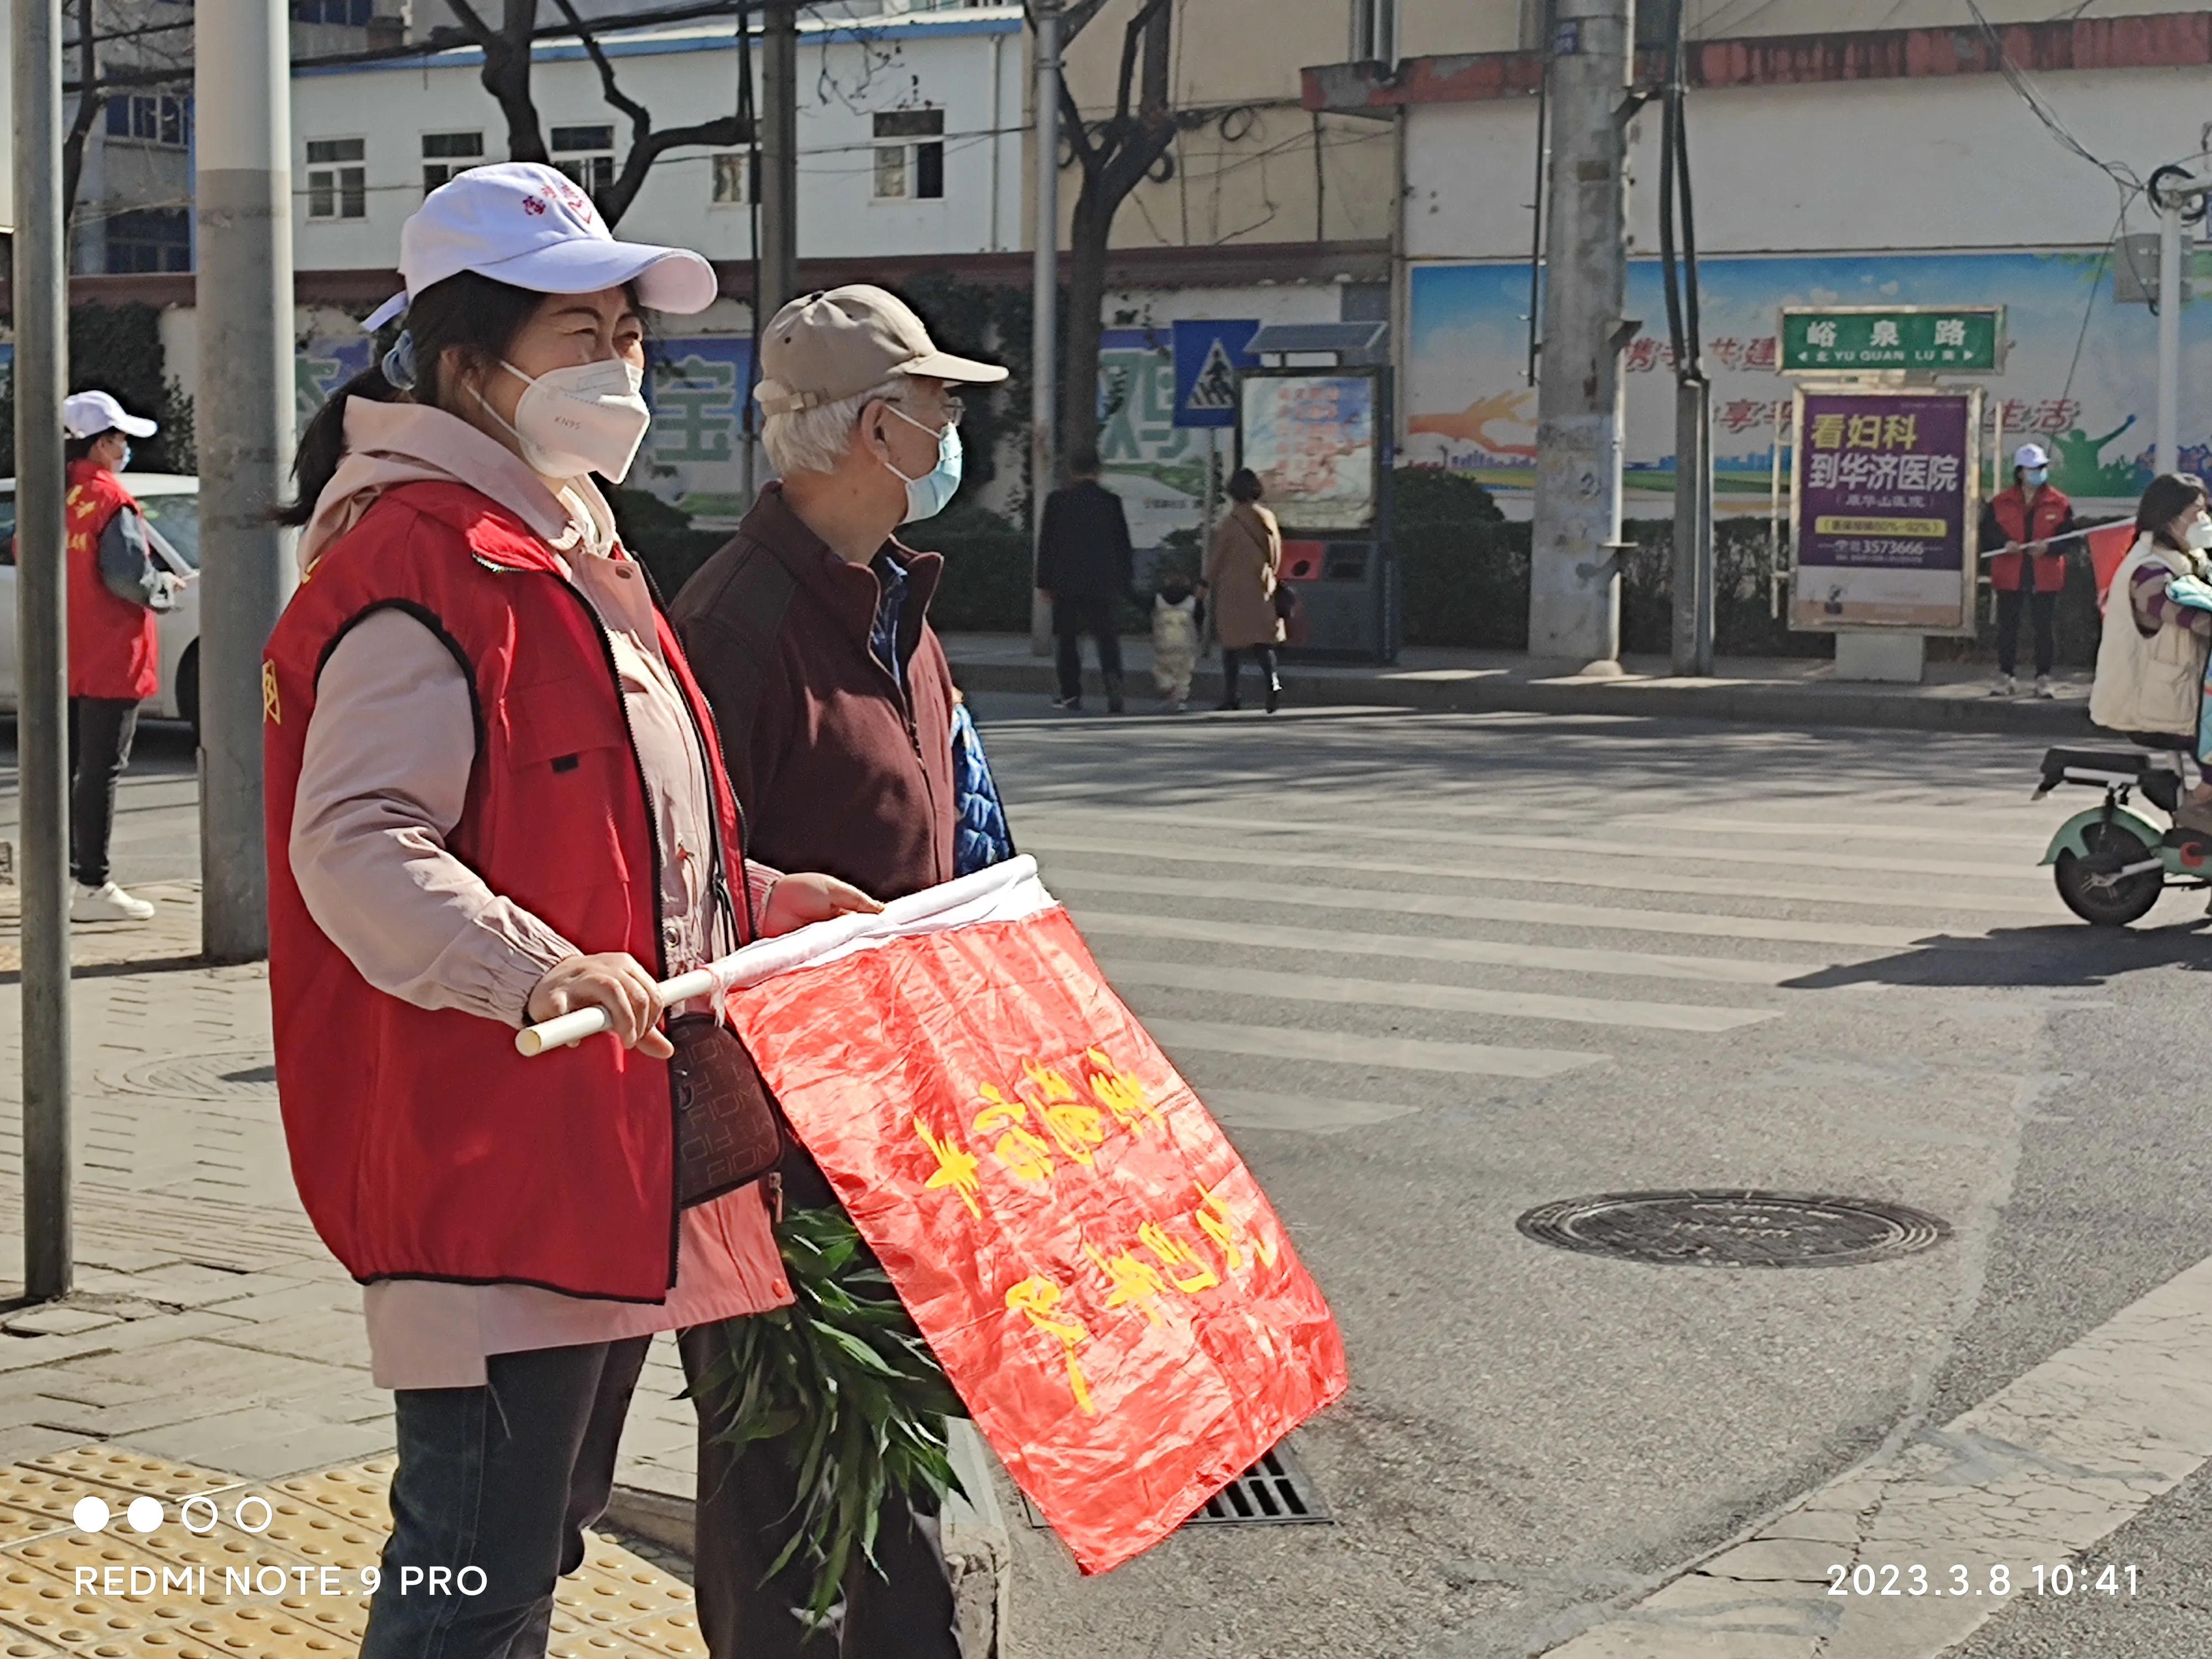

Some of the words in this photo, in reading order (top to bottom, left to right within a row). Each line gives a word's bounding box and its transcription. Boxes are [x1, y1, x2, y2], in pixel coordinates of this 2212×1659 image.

[1807, 320, 1965, 347] 峪泉路
[1834, 351, 1855, 361] YU
[1915, 351, 1935, 361] LU
[655, 357, 734, 461] 宝
[1983, 398, 2077, 432] 生活
[1811, 414, 1917, 450] 看妇科
[1808, 452, 1959, 492] 到华济医院
[1862, 540, 1925, 556] 3573666
